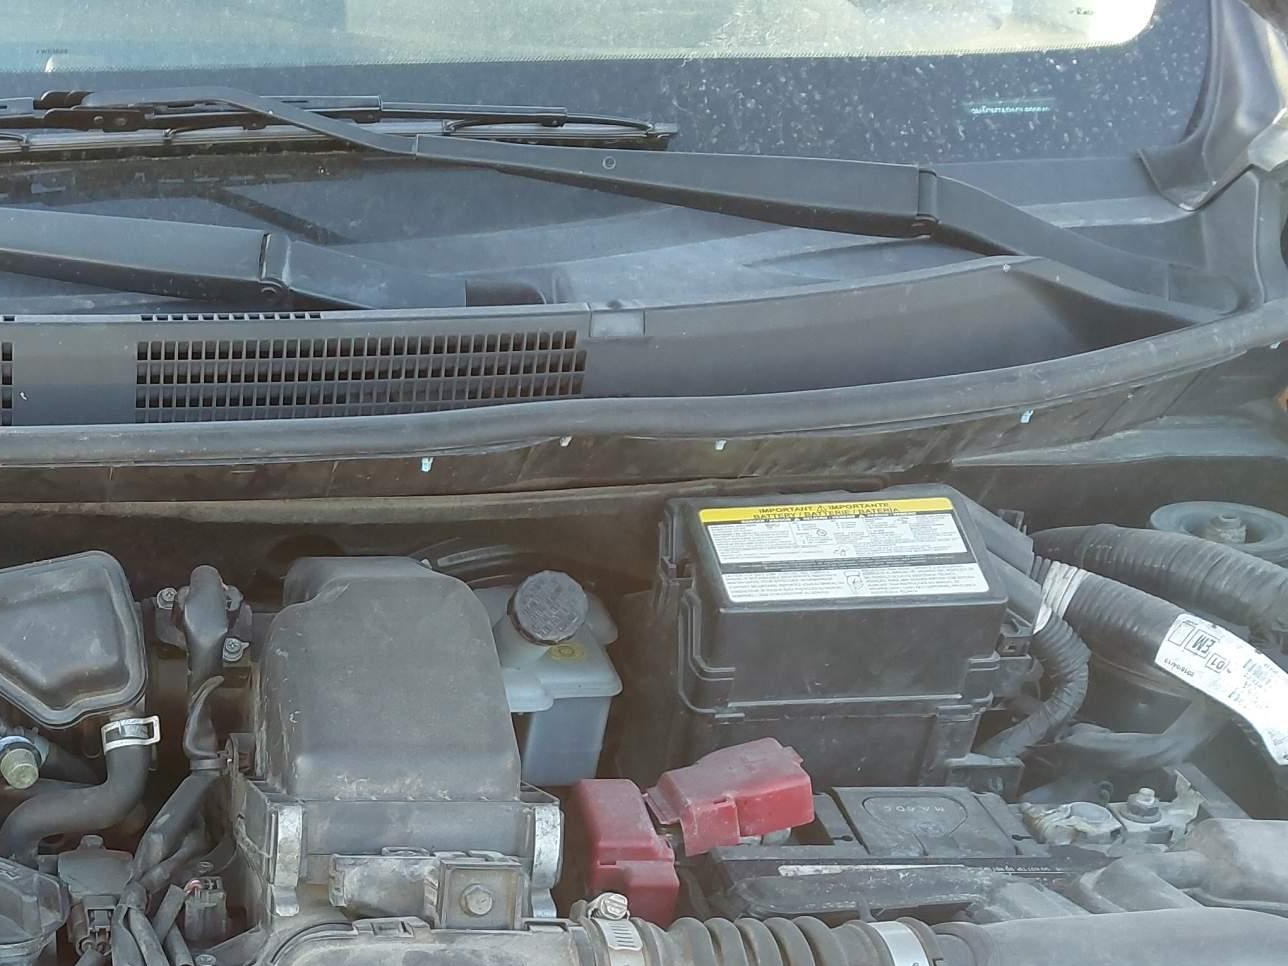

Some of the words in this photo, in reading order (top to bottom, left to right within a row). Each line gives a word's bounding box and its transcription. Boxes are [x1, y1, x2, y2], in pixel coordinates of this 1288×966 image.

[758, 505, 813, 514] IMPORTANT
[827, 501, 889, 510] IMPORTANTE
[753, 512, 795, 520] BATTERY
[804, 510, 851, 519] BATTERIE
[1192, 636, 1216, 654] EM
